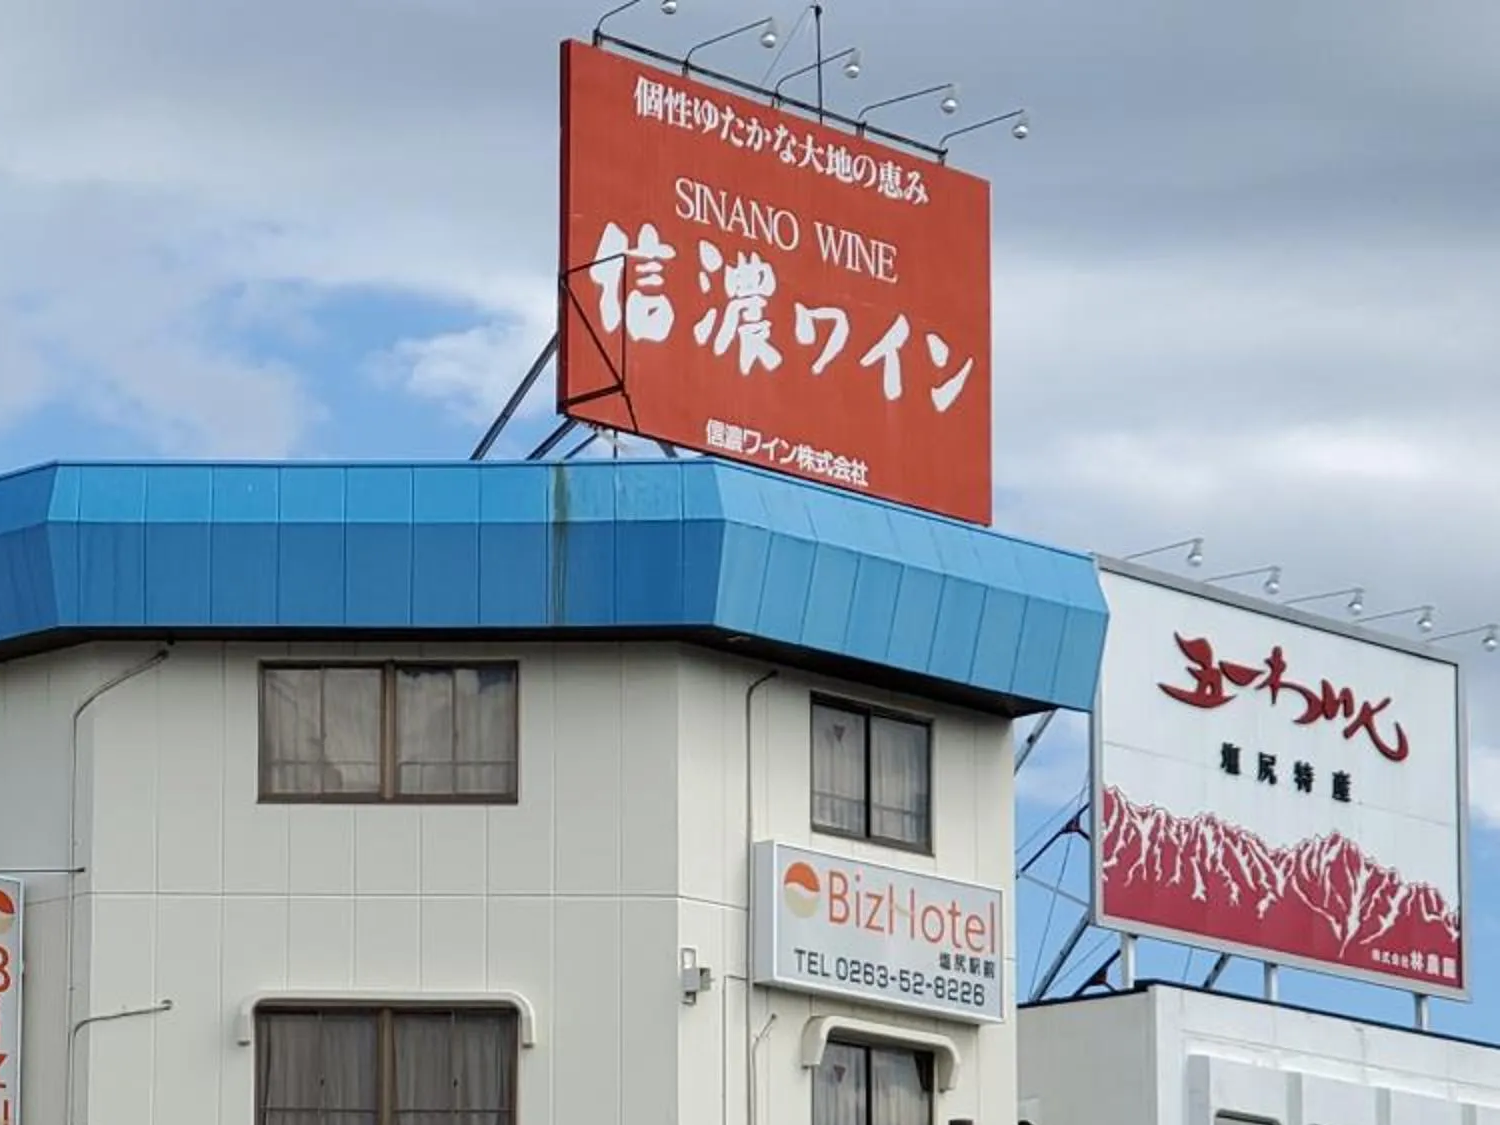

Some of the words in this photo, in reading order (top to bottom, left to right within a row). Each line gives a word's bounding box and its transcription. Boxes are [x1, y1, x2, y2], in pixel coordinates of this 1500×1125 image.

[633, 75, 929, 205] 個性ゆたかな大地の恵み
[675, 177, 800, 251] SINANO
[814, 221, 899, 284] WINE
[588, 222, 973, 412] 信濃ワイン
[706, 418, 869, 487] 信濃ワイン株式会社
[1220, 742, 1352, 803] 塩尻特産
[828, 870, 995, 955] BizHotel
[794, 947, 830, 977] TEL
[836, 957, 985, 1006] 0263-52-8226
